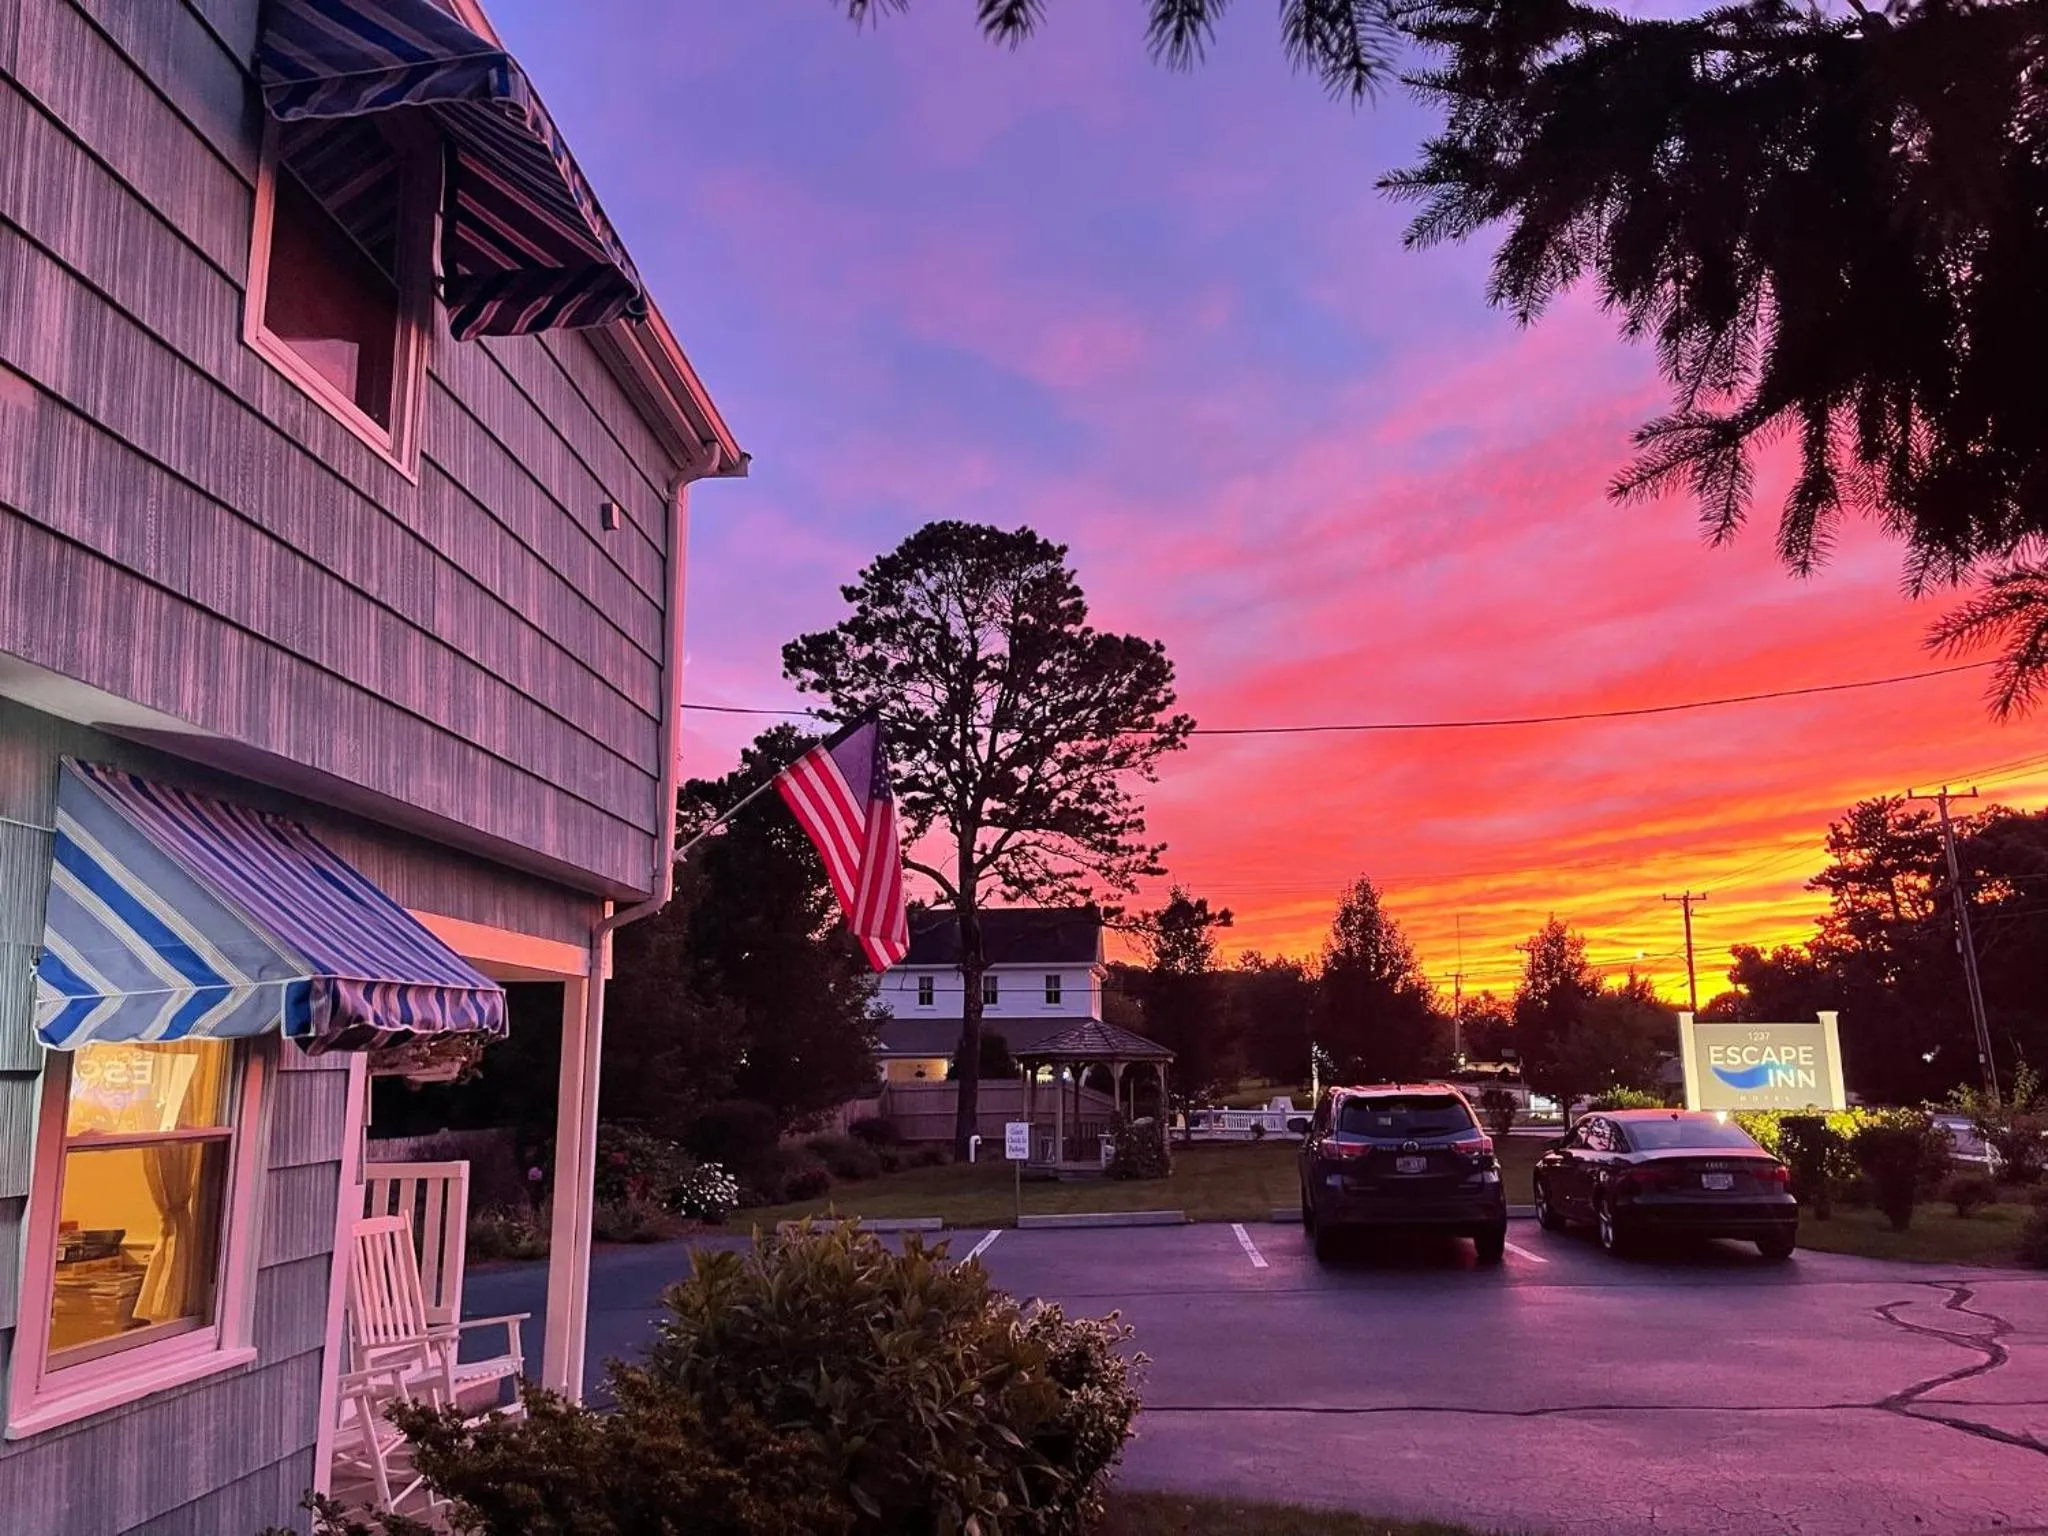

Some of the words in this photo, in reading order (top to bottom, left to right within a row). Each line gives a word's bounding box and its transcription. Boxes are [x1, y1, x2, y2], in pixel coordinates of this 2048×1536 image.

[1747, 1032, 1771, 1041] 1237
[1708, 1045, 1815, 1066] ESCAPE
[1768, 1068, 1817, 1089] INN
